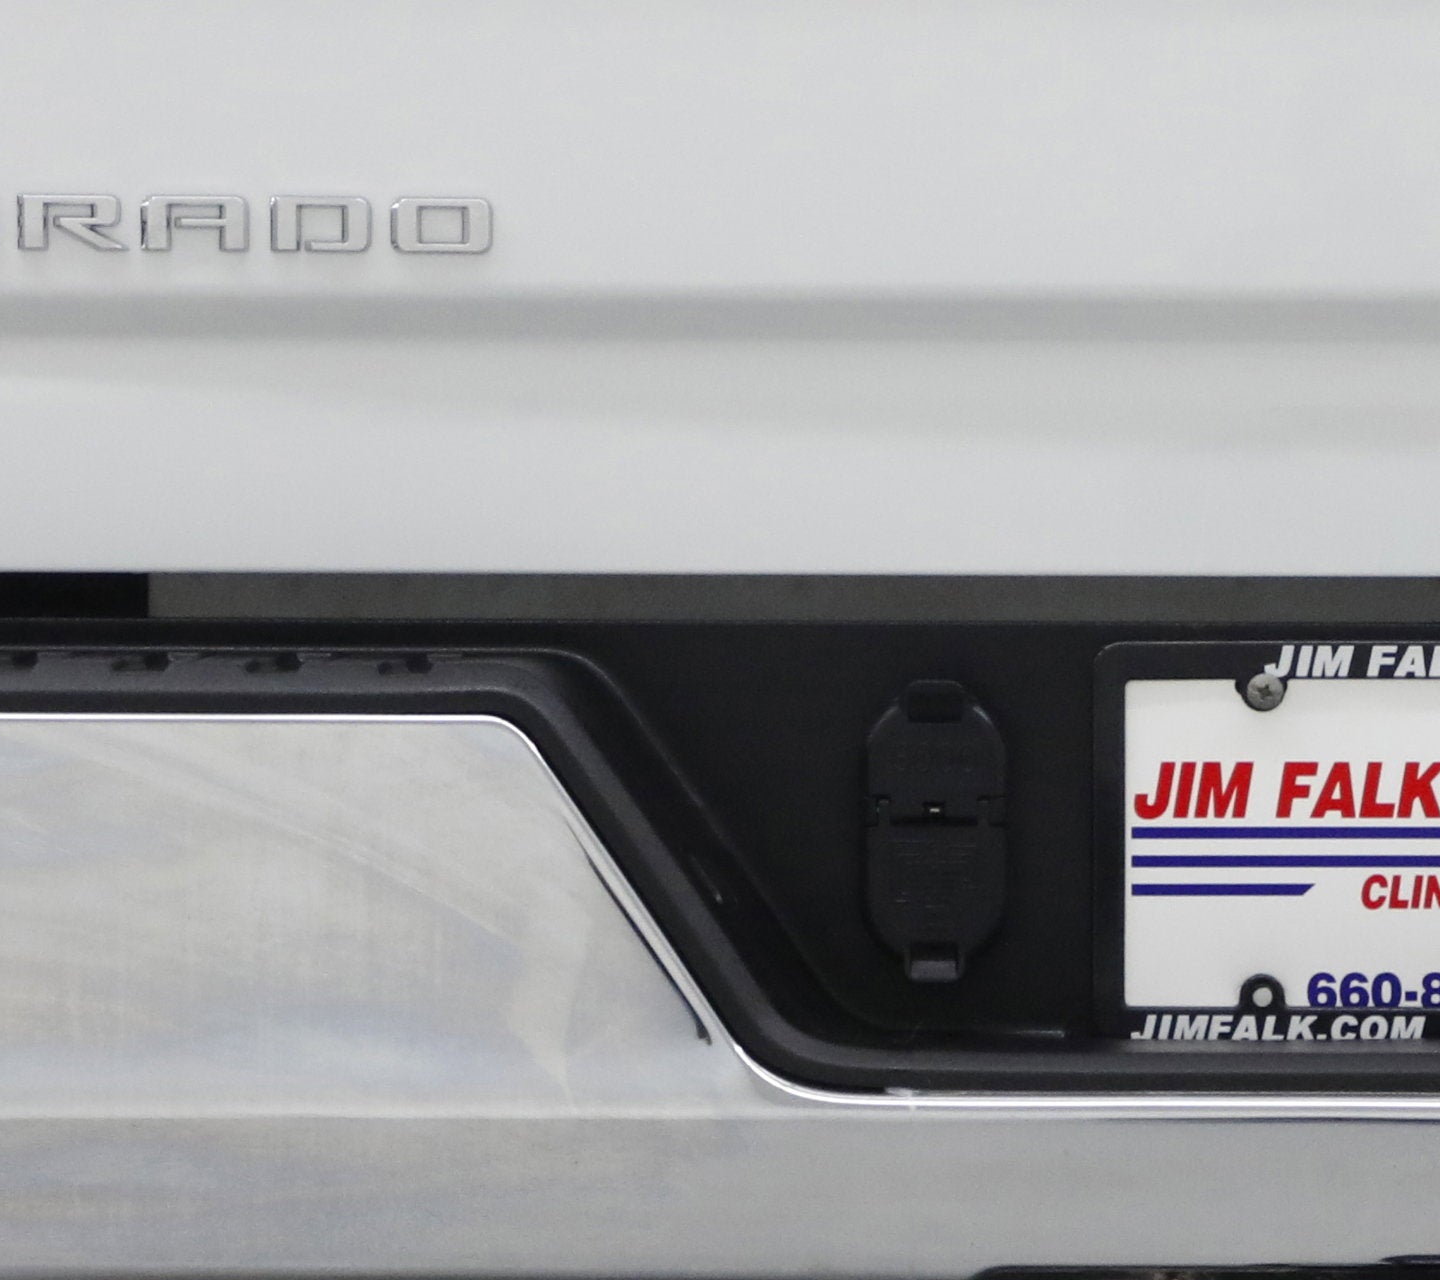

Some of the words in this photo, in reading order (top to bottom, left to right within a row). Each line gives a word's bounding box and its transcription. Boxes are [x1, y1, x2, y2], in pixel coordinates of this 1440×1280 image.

[1263, 644, 1356, 679] JIM
[1133, 760, 1254, 820] JIM
[1130, 1014, 1427, 1041] JIMFALK.COM
